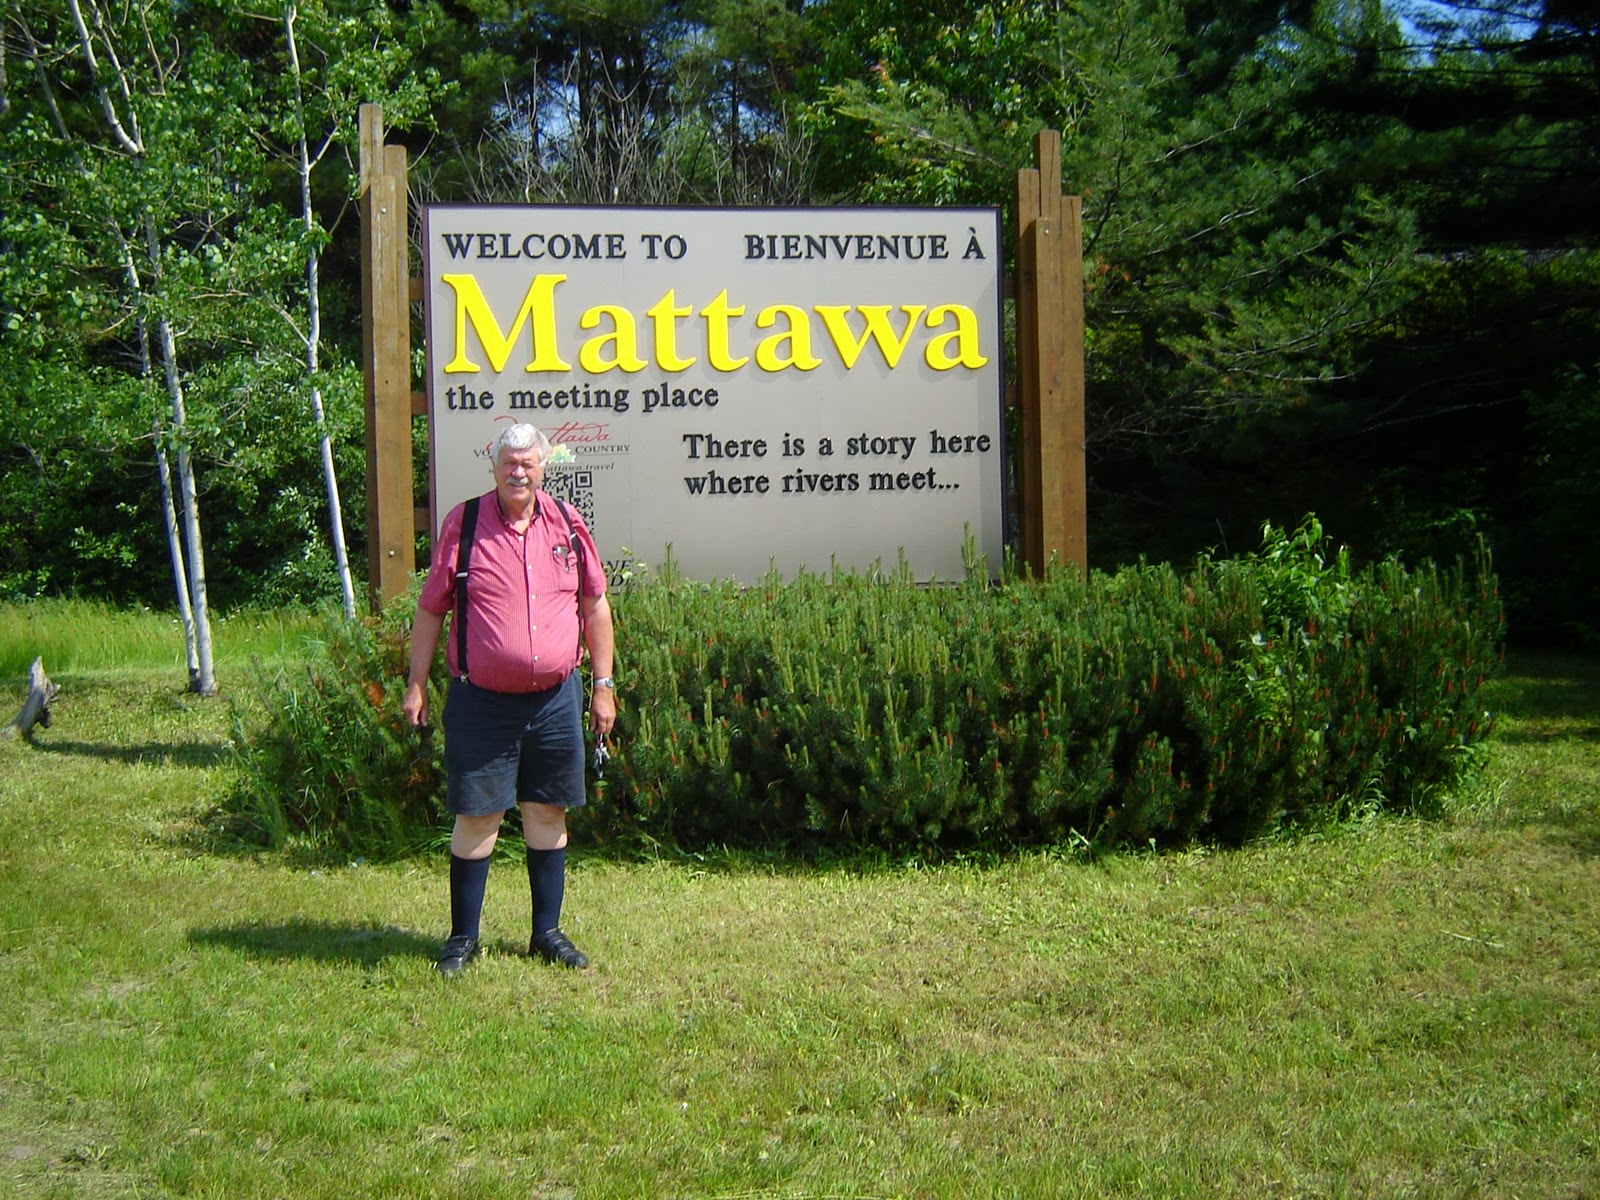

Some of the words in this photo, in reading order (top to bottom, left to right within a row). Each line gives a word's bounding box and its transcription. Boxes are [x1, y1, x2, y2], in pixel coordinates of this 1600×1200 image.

[442, 233, 627, 260] WELCOME
[641, 234, 688, 260] TO
[744, 234, 949, 260] BIENVENUE
[962, 226, 986, 260] À
[441, 273, 990, 374] Mattawa
[445, 384, 495, 410] the
[509, 383, 630, 412] meeting
[641, 382, 720, 412] place
[575, 445, 631, 455] COUNTRY
[683, 433, 768, 458] There
[782, 432, 805, 456] is
[818, 437, 834, 456] a
[846, 432, 916, 459] story
[929, 429, 991, 454] here
[684, 470, 769, 494] where
[781, 468, 860, 493] rivers
[868, 467, 960, 491] meet...
